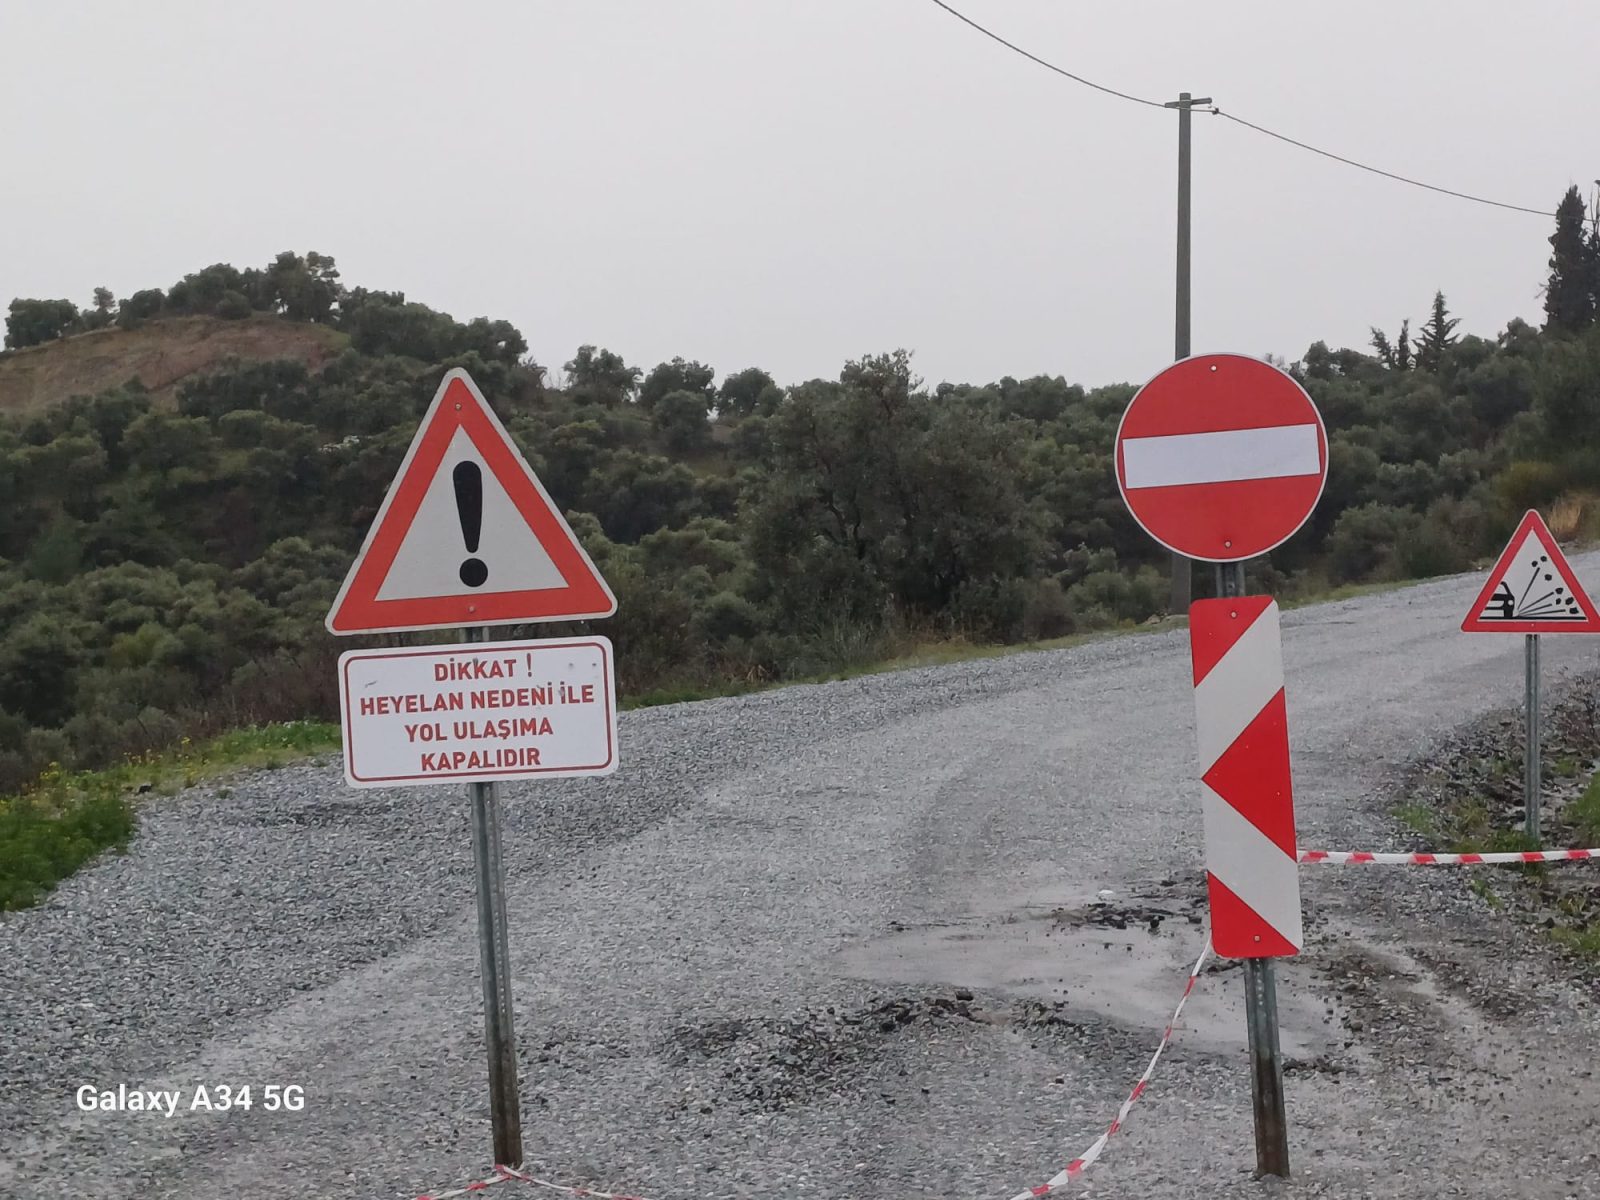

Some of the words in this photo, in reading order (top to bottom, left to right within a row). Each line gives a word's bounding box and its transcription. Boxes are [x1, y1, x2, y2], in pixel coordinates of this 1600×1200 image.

[434, 657, 517, 682] DİKKAT
[360, 691, 464, 716] HEYELAN
[470, 681, 553, 709] NEDENİ
[559, 681, 594, 704] İLE
[405, 722, 448, 742] YOL
[453, 717, 553, 740] ULAŞIMA
[421, 747, 541, 771] KAPALIDIR
